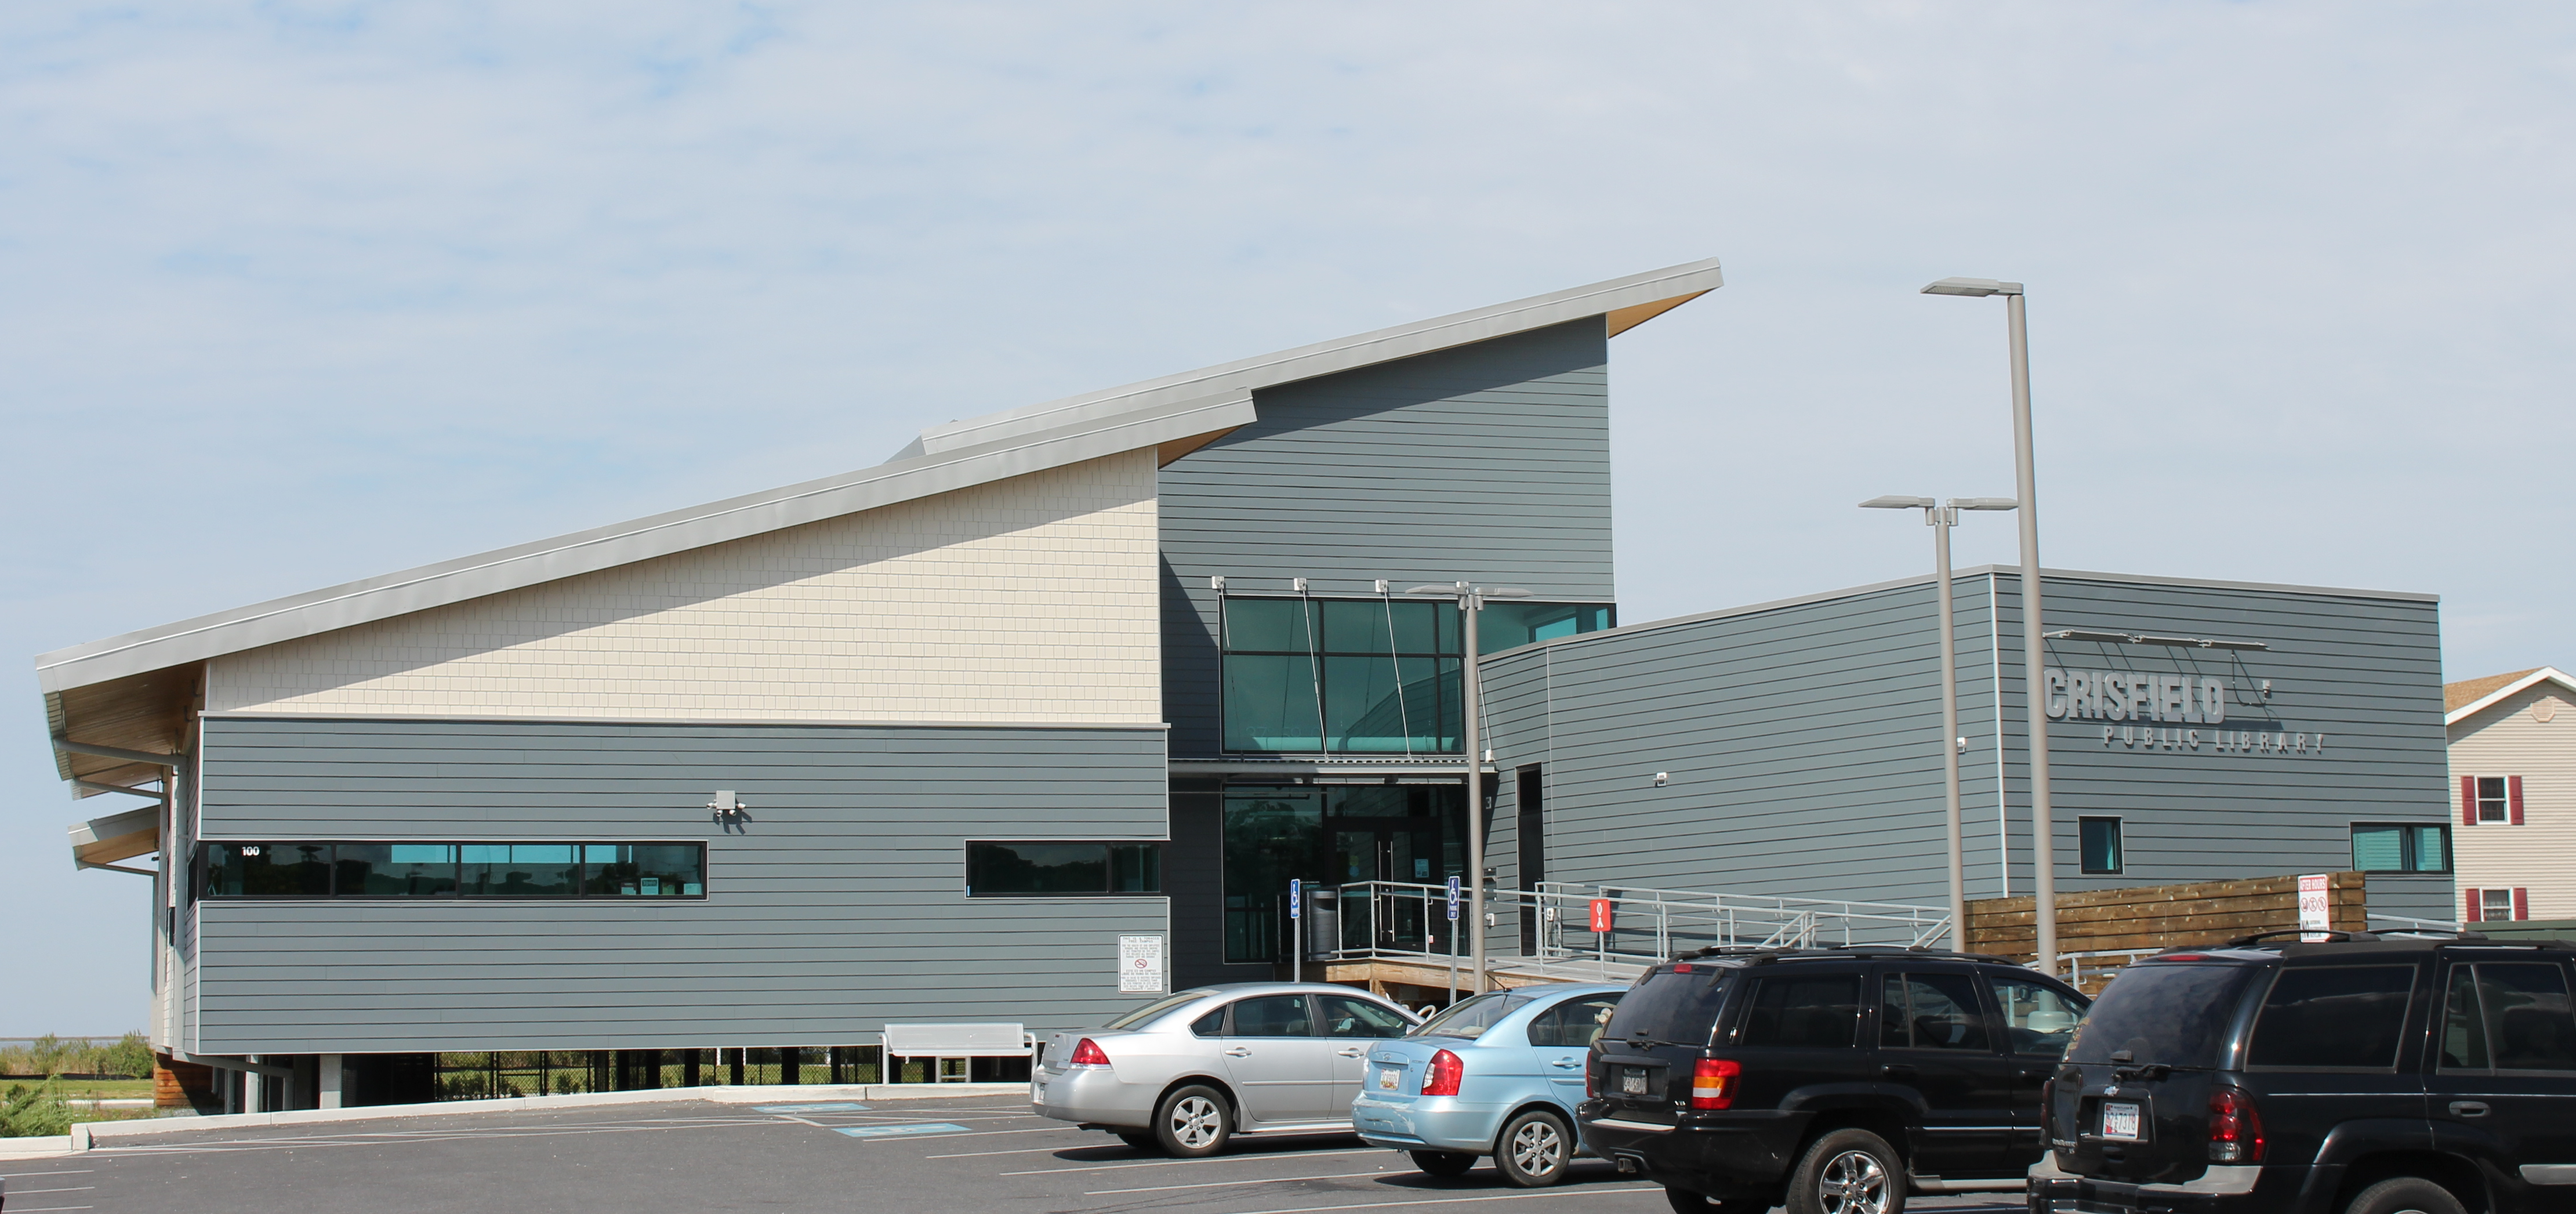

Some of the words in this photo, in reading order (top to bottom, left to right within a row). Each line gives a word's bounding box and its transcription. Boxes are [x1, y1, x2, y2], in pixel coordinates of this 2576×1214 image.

[2044, 668, 2225, 724] CRISFIELD
[2103, 726, 2199, 748] PUBLIC
[2215, 730, 2324, 752] LIBRARY
[242, 846, 260, 856] 100
[2299, 879, 2311, 890] AFTER
[2312, 878, 2325, 890] HOURS
